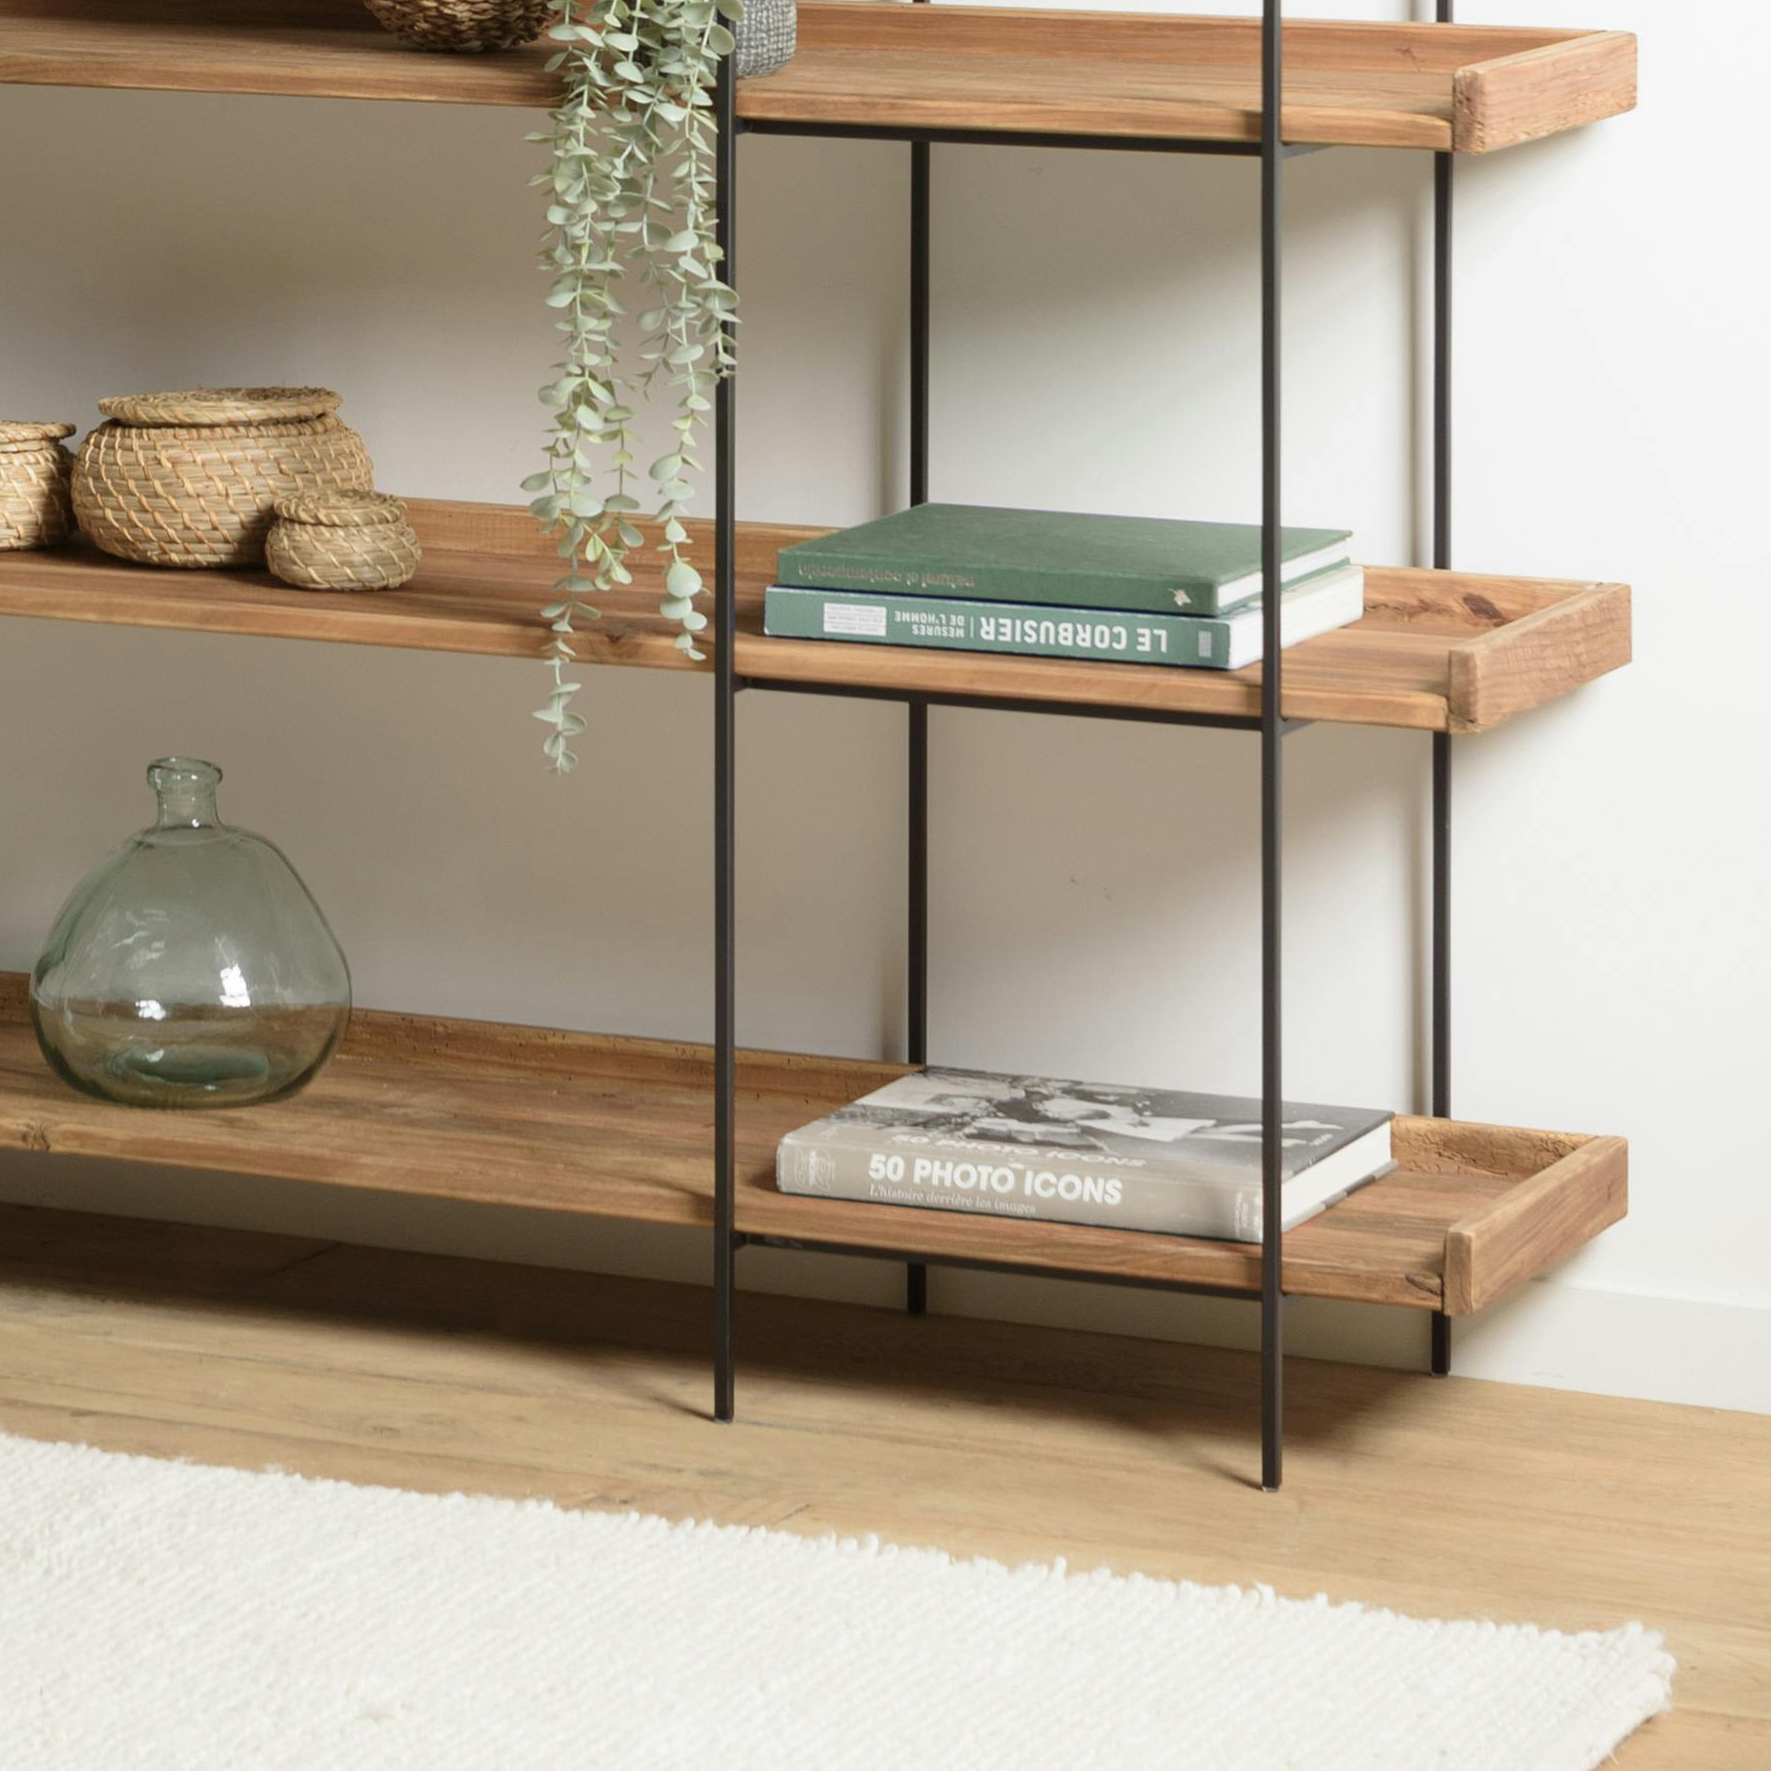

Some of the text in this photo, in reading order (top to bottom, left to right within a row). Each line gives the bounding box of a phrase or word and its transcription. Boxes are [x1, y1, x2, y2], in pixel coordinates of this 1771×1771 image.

[894, 610, 947, 626] L'HOMME
[911, 624, 965, 639] MESURES
[948, 614, 965, 627] DE
[979, 616, 1128, 651] CORBUSIER
[1136, 627, 1168, 653] LE
[890, 1133, 1148, 1168] 50 PHOTO ICONS
[868, 1153, 905, 1182] 50
[913, 1157, 1016, 1195] PHOTO
[1023, 1169, 1124, 1206] ICONS
[868, 1182, 1038, 1215] L'histoire derrière les images
